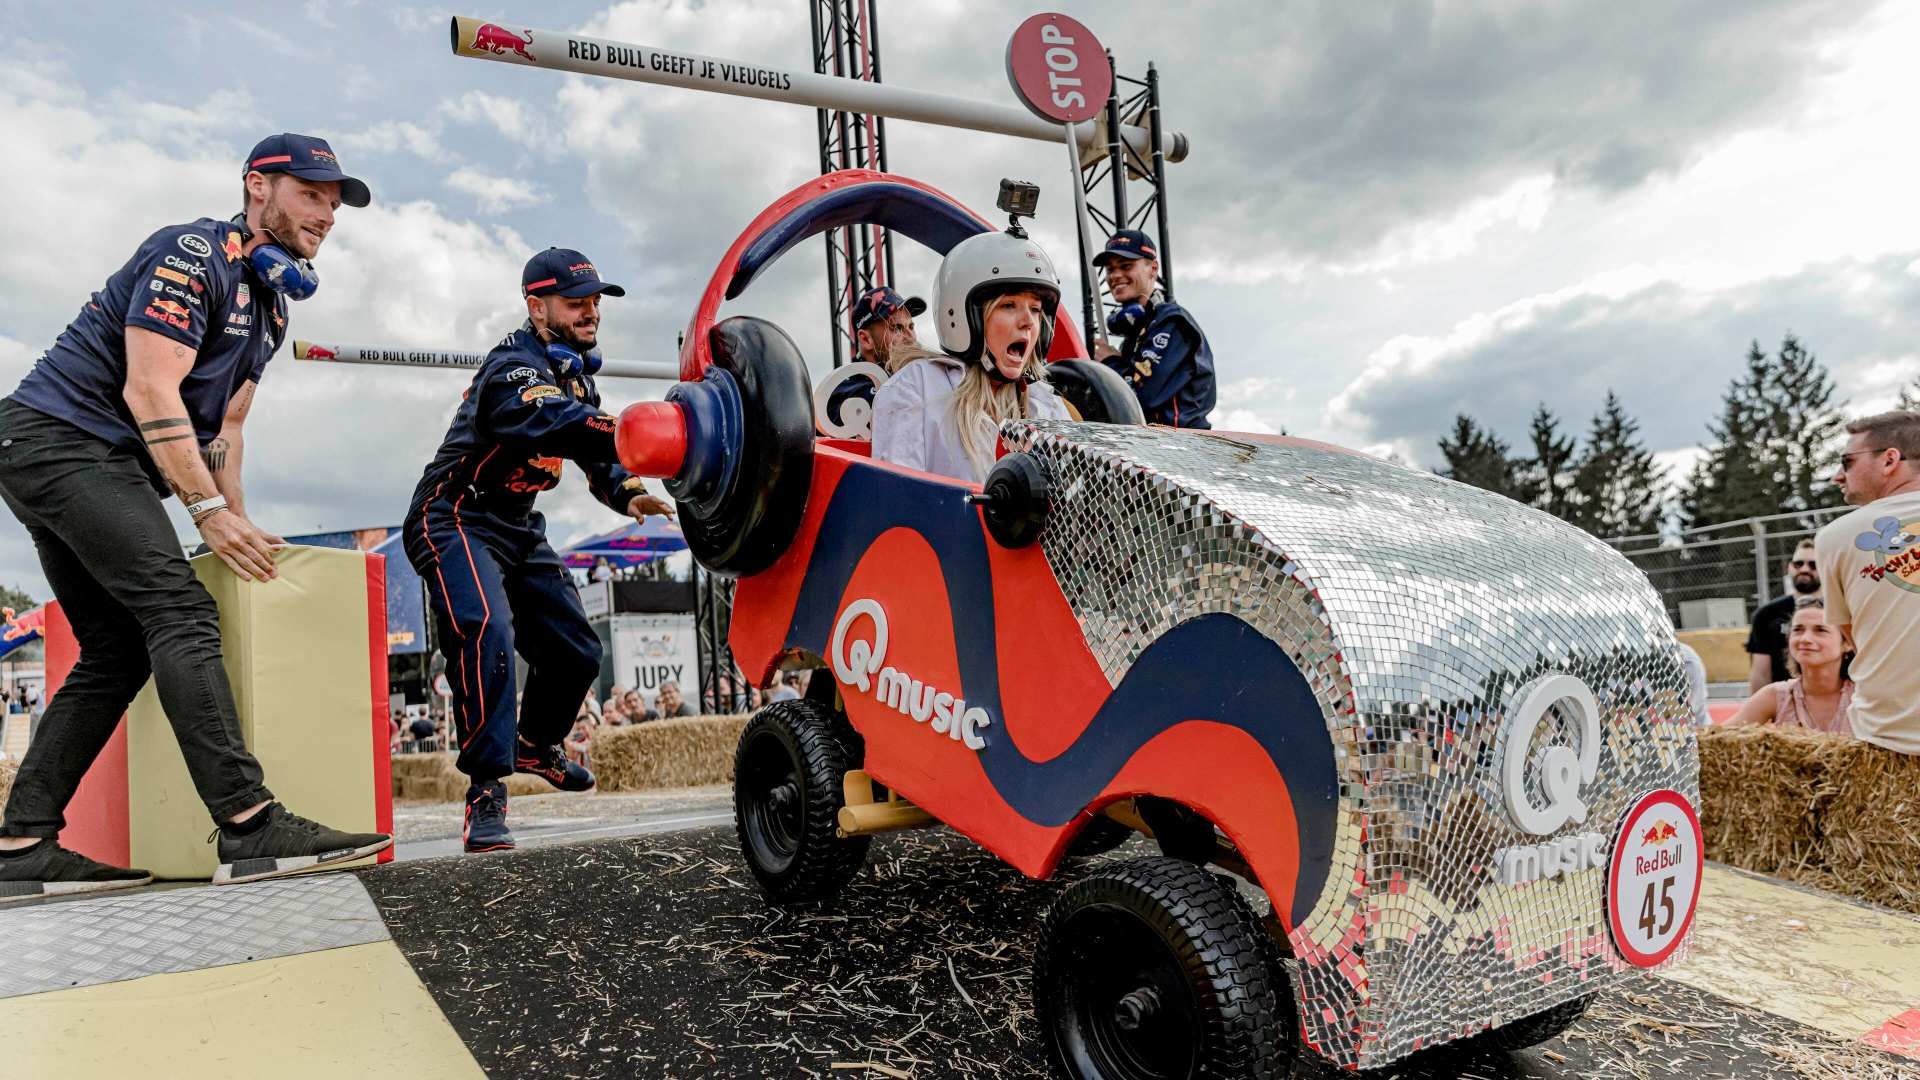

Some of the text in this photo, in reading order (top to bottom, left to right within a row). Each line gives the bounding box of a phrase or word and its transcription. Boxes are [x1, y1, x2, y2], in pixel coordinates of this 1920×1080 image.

[568, 39, 791, 90] RED BULL GEEFT JE VLEUGELS
[1041, 24, 1085, 109] STOP
[183, 236, 207, 253] Esso
[165, 255, 200, 275] Claro
[165, 286, 201, 305] Cash App
[145, 306, 190, 330] Red Bull
[360, 349, 380, 361] RED
[382, 351, 406, 362] BULL
[409, 352, 436, 364] GEEFT
[440, 353, 449, 364] JE
[832, 599, 888, 692] Q
[633, 664, 683, 690] JURY
[1502, 674, 1601, 836] Q
[1636, 843, 1682, 876] Red Bull
[1638, 876, 1675, 940] 45
